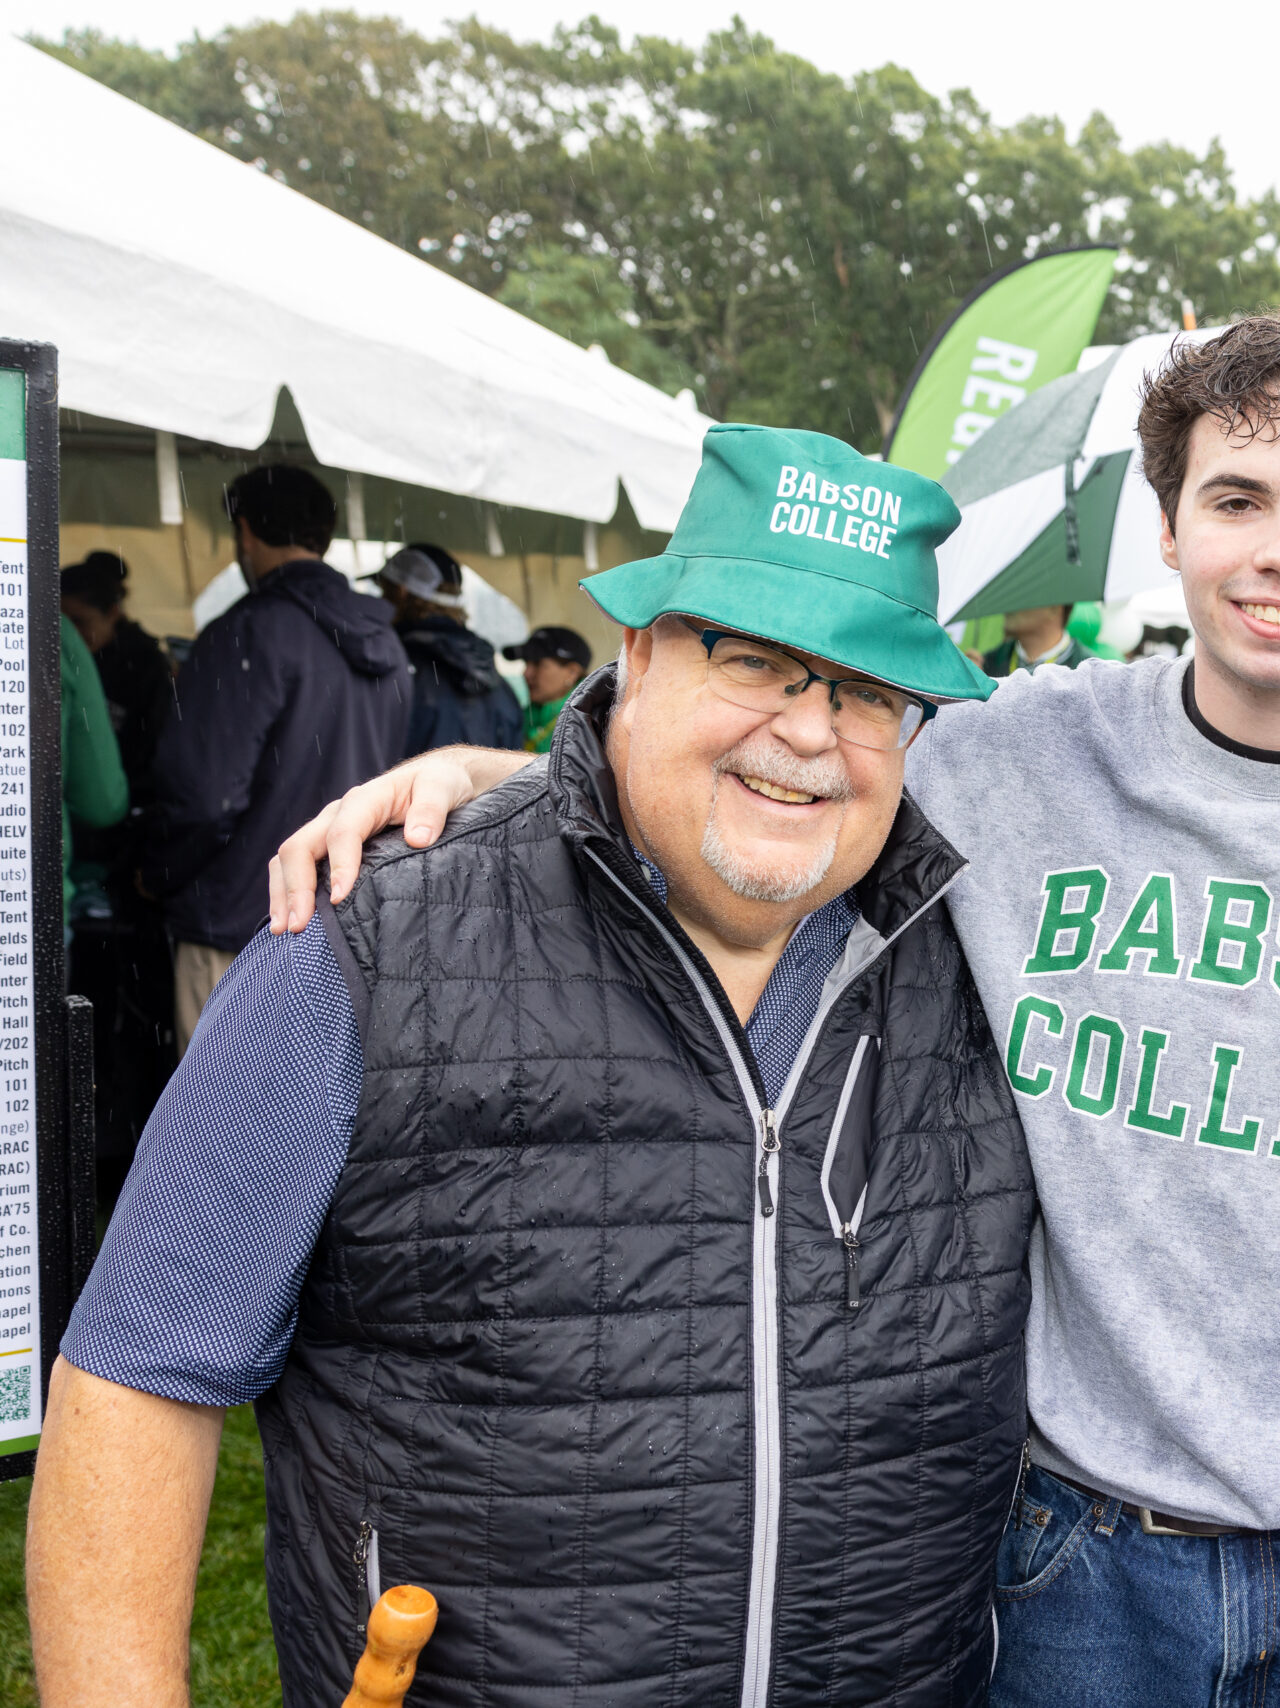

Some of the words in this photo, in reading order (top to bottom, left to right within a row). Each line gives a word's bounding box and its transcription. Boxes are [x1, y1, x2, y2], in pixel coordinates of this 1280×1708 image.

[776, 465, 902, 525] BABSON
[769, 501, 897, 559] COLLEGE
[0, 561, 24, 575] ent
[0, 621, 24, 634] ate
[5, 636, 24, 650] Lot
[1, 680, 25, 693] 120
[1, 724, 25, 736] 102
[0, 746, 26, 758] ark
[1, 783, 24, 795] 241
[1, 847, 26, 859] uite
[1, 869, 27, 881] uts)
[0, 890, 27, 902] Tent
[0, 911, 27, 923] Tent
[0, 932, 28, 945] elds
[1, 975, 28, 987] nter
[3, 1016, 28, 1029] Hall
[5, 1079, 27, 1092] 101
[6, 1099, 29, 1112] 102
[1, 1120, 29, 1136] nge)
[0, 1141, 29, 1155] RAC
[0, 1202, 30, 1217] A'75
[9, 1224, 31, 1237] Co.
[0, 1302, 31, 1319] apel
[0, 1322, 31, 1340] apel
